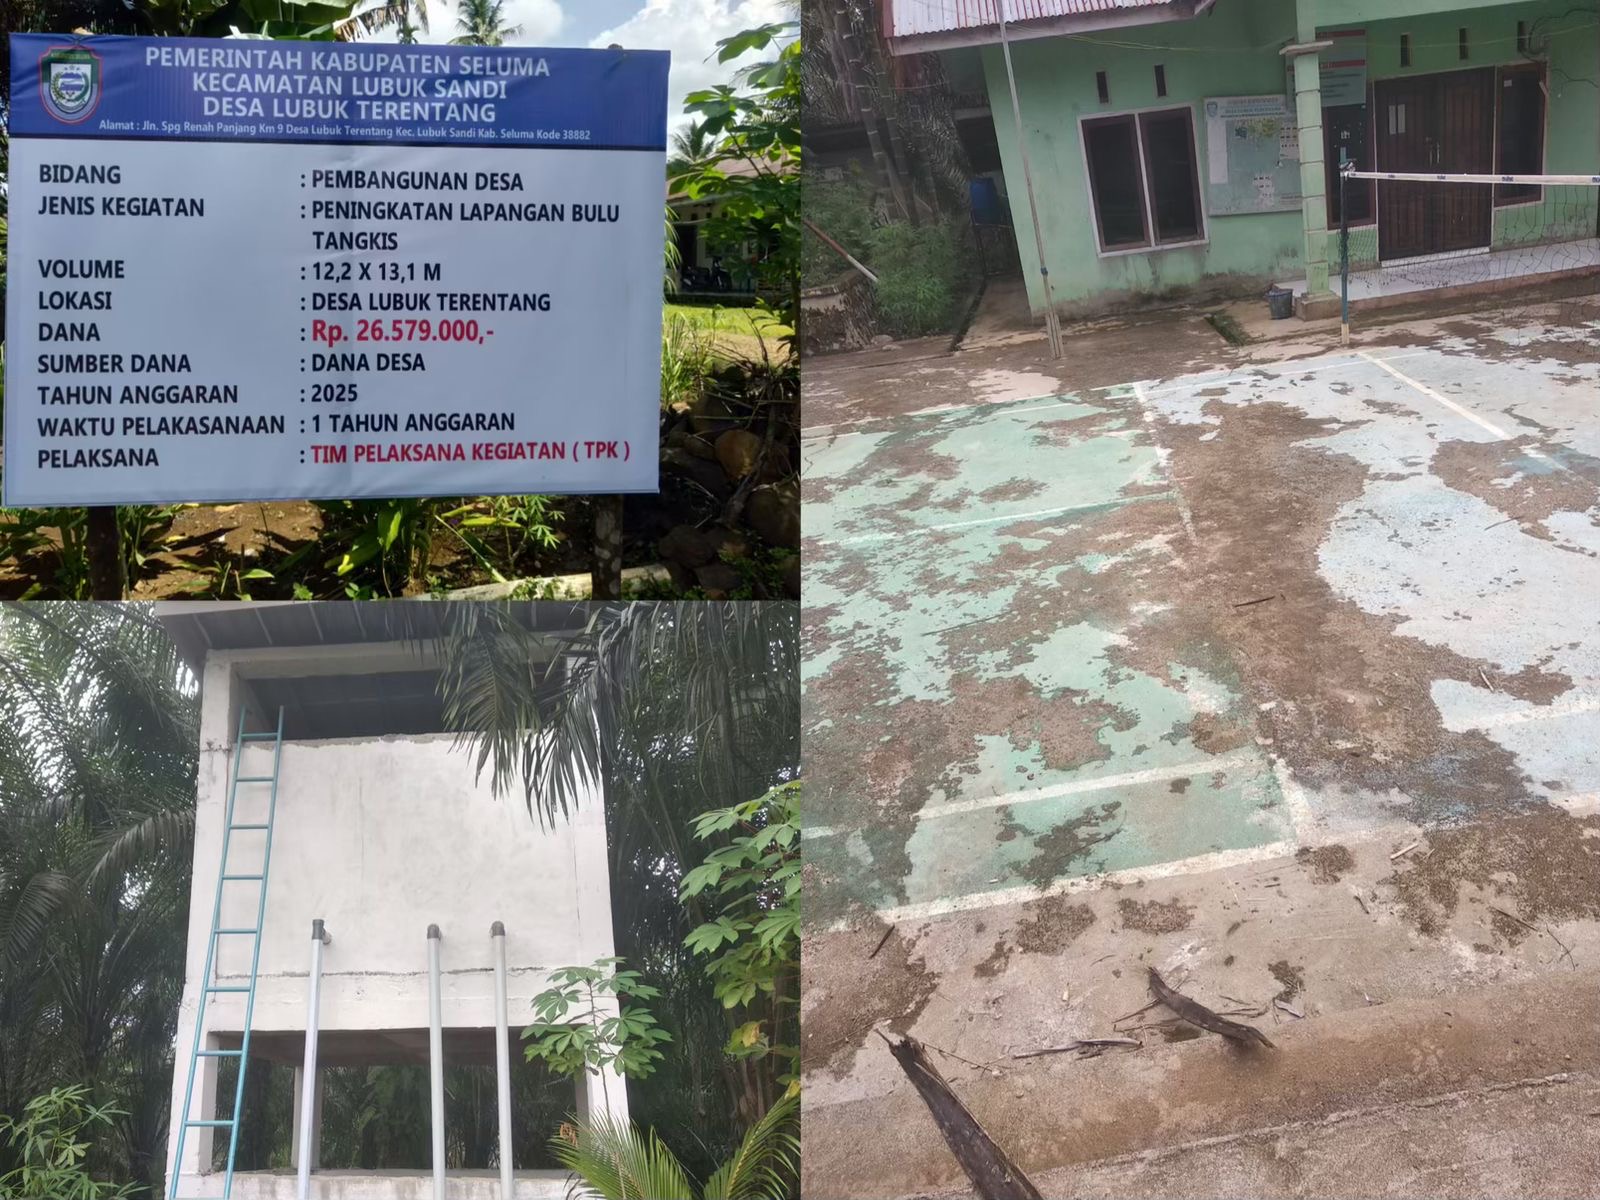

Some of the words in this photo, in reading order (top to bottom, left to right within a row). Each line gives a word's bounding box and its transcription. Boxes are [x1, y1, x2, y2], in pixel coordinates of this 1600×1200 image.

[146, 47, 302, 70] PEMERINTAH
[312, 52, 449, 73] KABUPATEN
[459, 56, 549, 77] SELUMA
[193, 73, 342, 95] KECAMATAN
[353, 77, 426, 97] LUBUK
[434, 79, 507, 98] SANDI
[204, 97, 264, 116] DESA
[274, 98, 348, 118] LUBUK
[357, 101, 495, 122] TERENTANG
[99, 120, 134, 130] Alamat
[142, 121, 158, 130] Jln.
[162, 121, 180, 134] Spg
[184, 122, 214, 132] Renah
[217, 122, 256, 135] Panjang
[259, 123, 275, 133] Km
[278, 124, 283, 133] 9
[286, 124, 308, 134] Desa
[312, 125, 341, 135] Lubuk
[345, 126, 393, 139] Terentang
[396, 127, 414, 136] Kec.
[417, 127, 446, 137] Lubuk
[450, 128, 475, 137] Sandi
[478, 128, 497, 138] Kab.
[501, 129, 534, 138] Seluma
[537, 129, 560, 139] Kode
[563, 130, 590, 140] 38882
[40, 165, 120, 184] BIDANG
[313, 170, 467, 190] PEMBANGUNAN
[476, 173, 523, 191] DESA
[38, 196, 94, 215] JENIS
[103, 197, 204, 216] KEGIATAN
[313, 201, 452, 220] PENINGKATAN
[461, 203, 564, 221] LAPANGAN
[572, 204, 619, 222] BULU
[313, 232, 397, 250] TANGKIS
[39, 260, 124, 278] VOLUME
[313, 262, 351, 283] 12,2
[359, 263, 371, 280] X
[379, 263, 414, 283] 13,1
[424, 263, 440, 281] M
[39, 291, 111, 310] LOKASI
[313, 293, 362, 311] DESA
[370, 293, 430, 311] LUBUK
[437, 293, 550, 311] TERENTANG
[39, 323, 100, 341] DANA
[313, 320, 348, 347] Rp.
[357, 319, 493, 344] 26.579.000,-
[38, 355, 123, 373] SUMBER
[131, 354, 191, 372] DANA
[312, 353, 370, 371] DANA
[377, 353, 425, 371] DESA
[37, 386, 111, 405] TAHUN
[120, 385, 237, 404] ANGGARAN
[312, 384, 357, 402] 2025
[38, 418, 114, 437] WAKTU
[123, 416, 284, 435] PELAKASANAAN
[313, 415, 319, 432] 1
[329, 414, 397, 432] TAHUN
[405, 413, 514, 431] ANGGARAN
[39, 448, 159, 468] PELAKSANA
[311, 445, 346, 463] TIM
[355, 444, 465, 462] PELAKSANA
[472, 442, 565, 460] KEGIATAN
[584, 441, 618, 458] TPK
